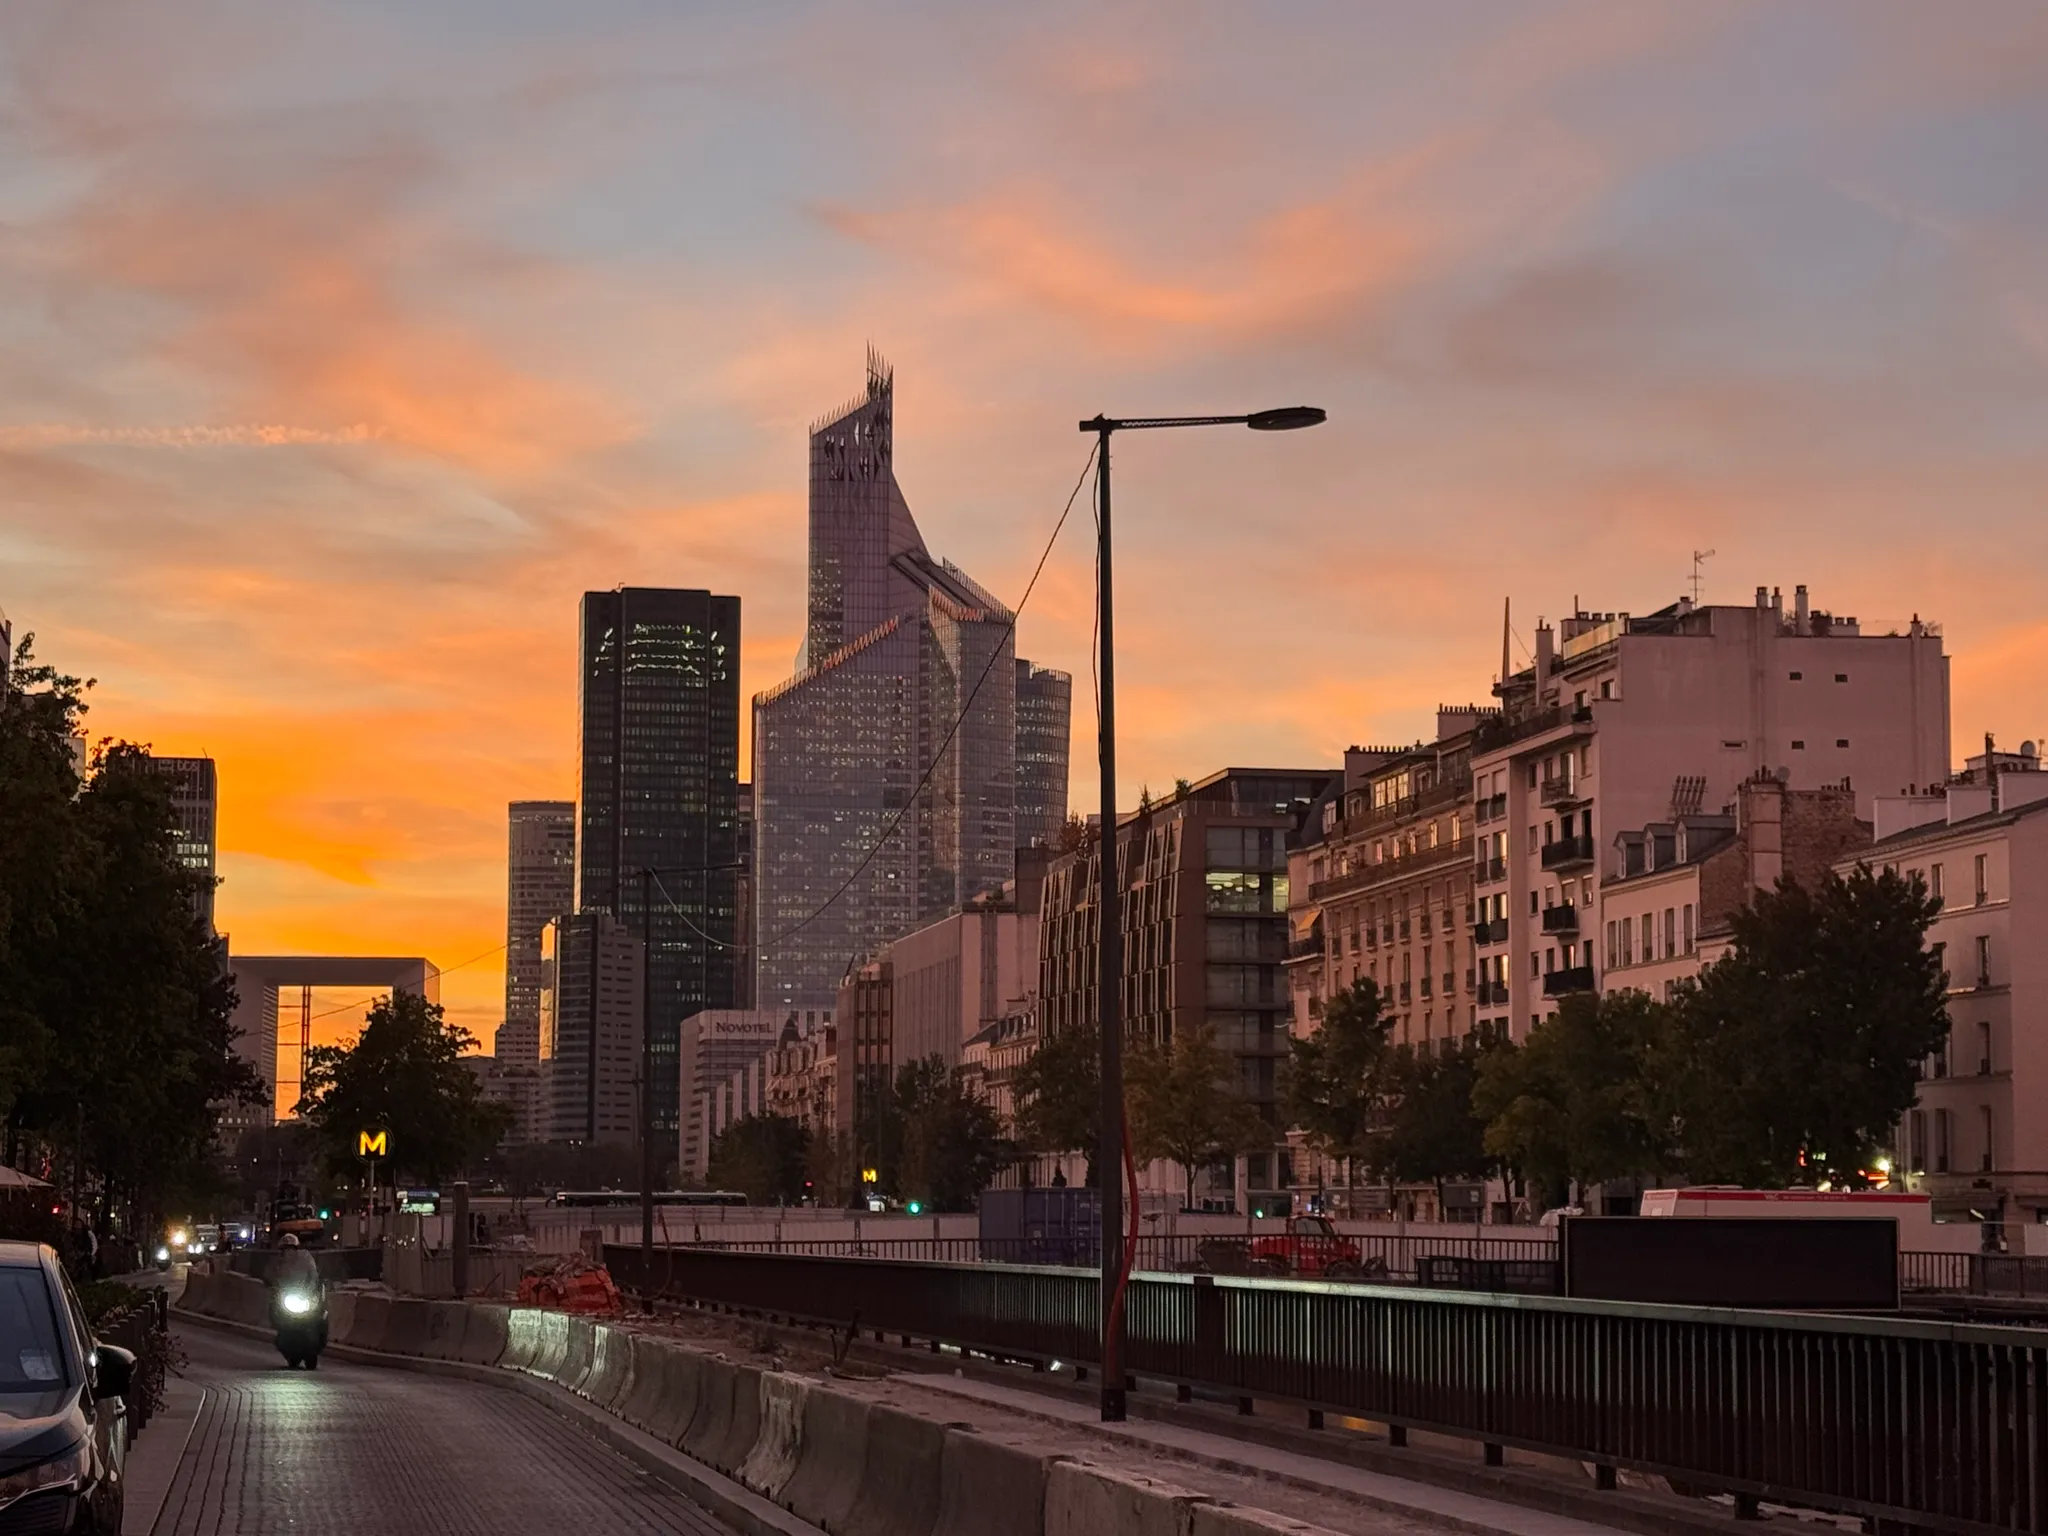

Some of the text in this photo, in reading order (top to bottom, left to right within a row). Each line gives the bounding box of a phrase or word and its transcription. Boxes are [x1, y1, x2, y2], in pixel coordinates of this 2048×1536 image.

[716, 1022, 773, 1033] NOVOTEL
[359, 1130, 387, 1156] M
[863, 1168, 877, 1183] M
